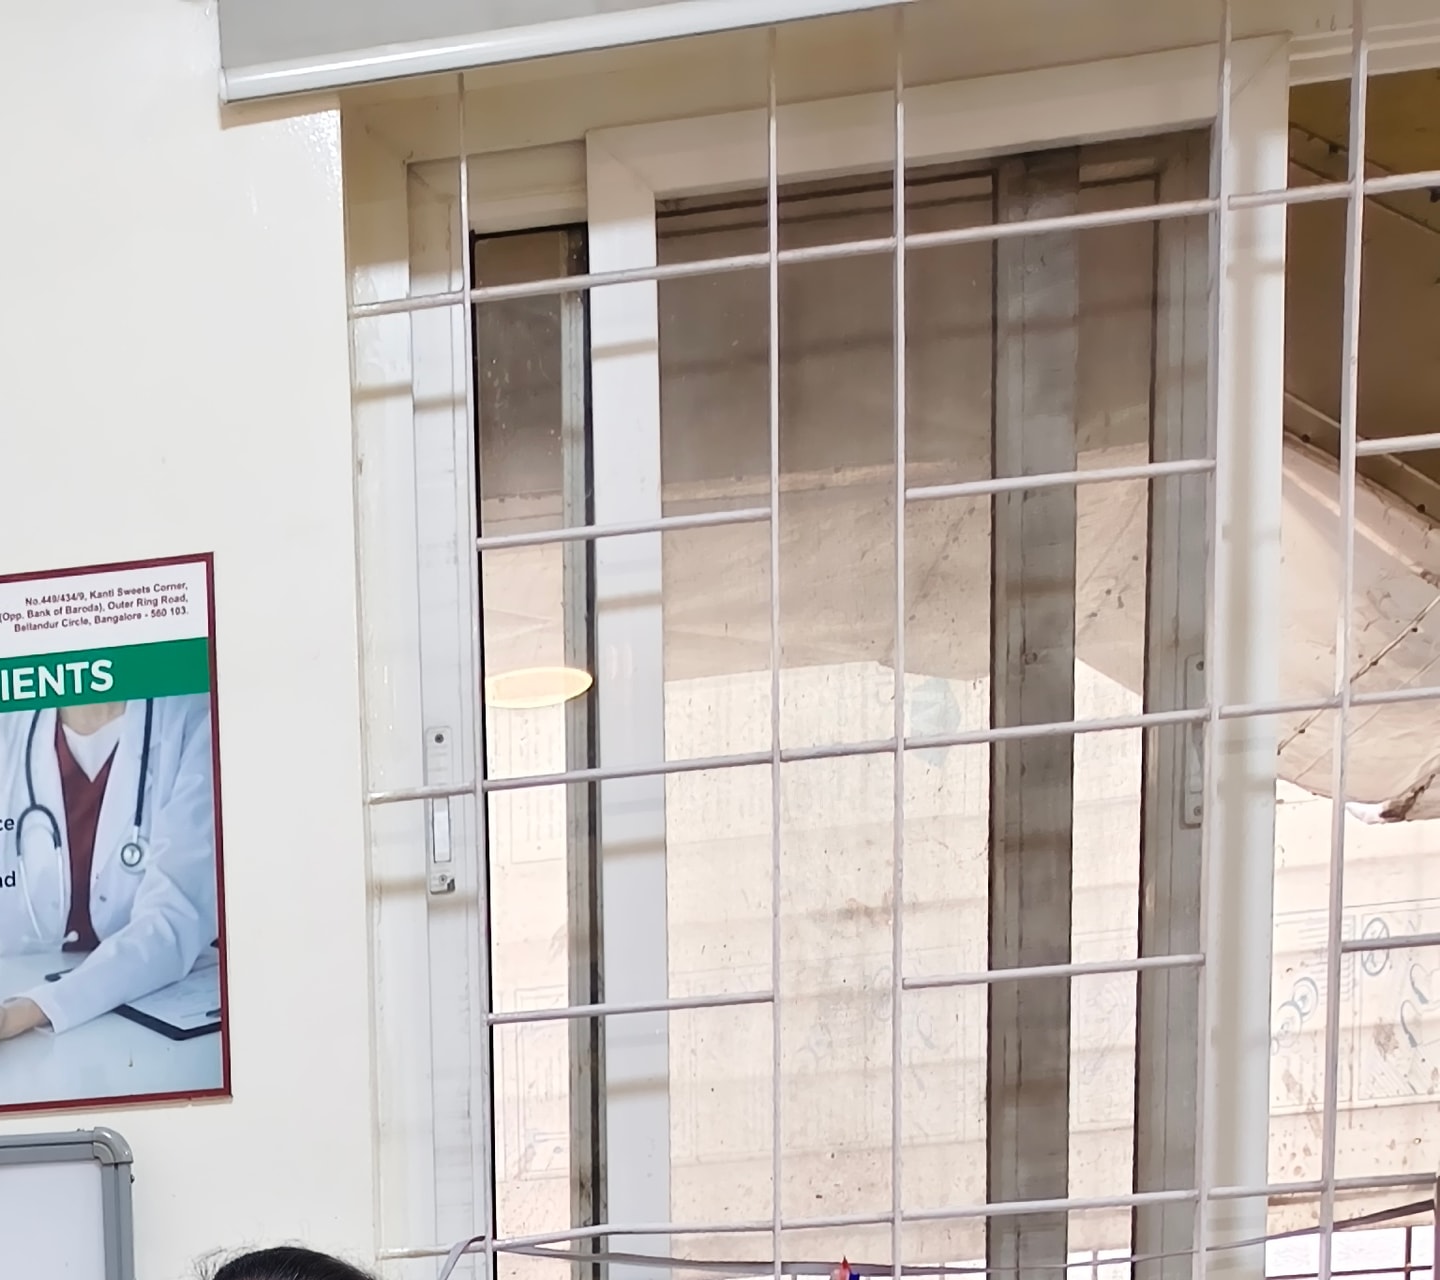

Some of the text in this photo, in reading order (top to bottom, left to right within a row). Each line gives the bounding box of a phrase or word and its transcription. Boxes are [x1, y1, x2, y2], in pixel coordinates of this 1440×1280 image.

[89, 589, 115, 600] Kanti
[117, 585, 151, 597] Sweets
[153, 582, 188, 593] Corner,
[26, 608, 51, 619] Bank
[53, 606, 63, 616] of
[65, 602, 105, 615] Baroda),
[107, 600, 134, 610] Outer
[136, 597, 159, 608] Ring
[160, 593, 189, 605] Road,
[13, 620, 59, 633] Bellandur
[61, 616, 92, 628] Circle,
[94, 612, 142, 625] Bangalore
[150, 607, 168, 618] 560
